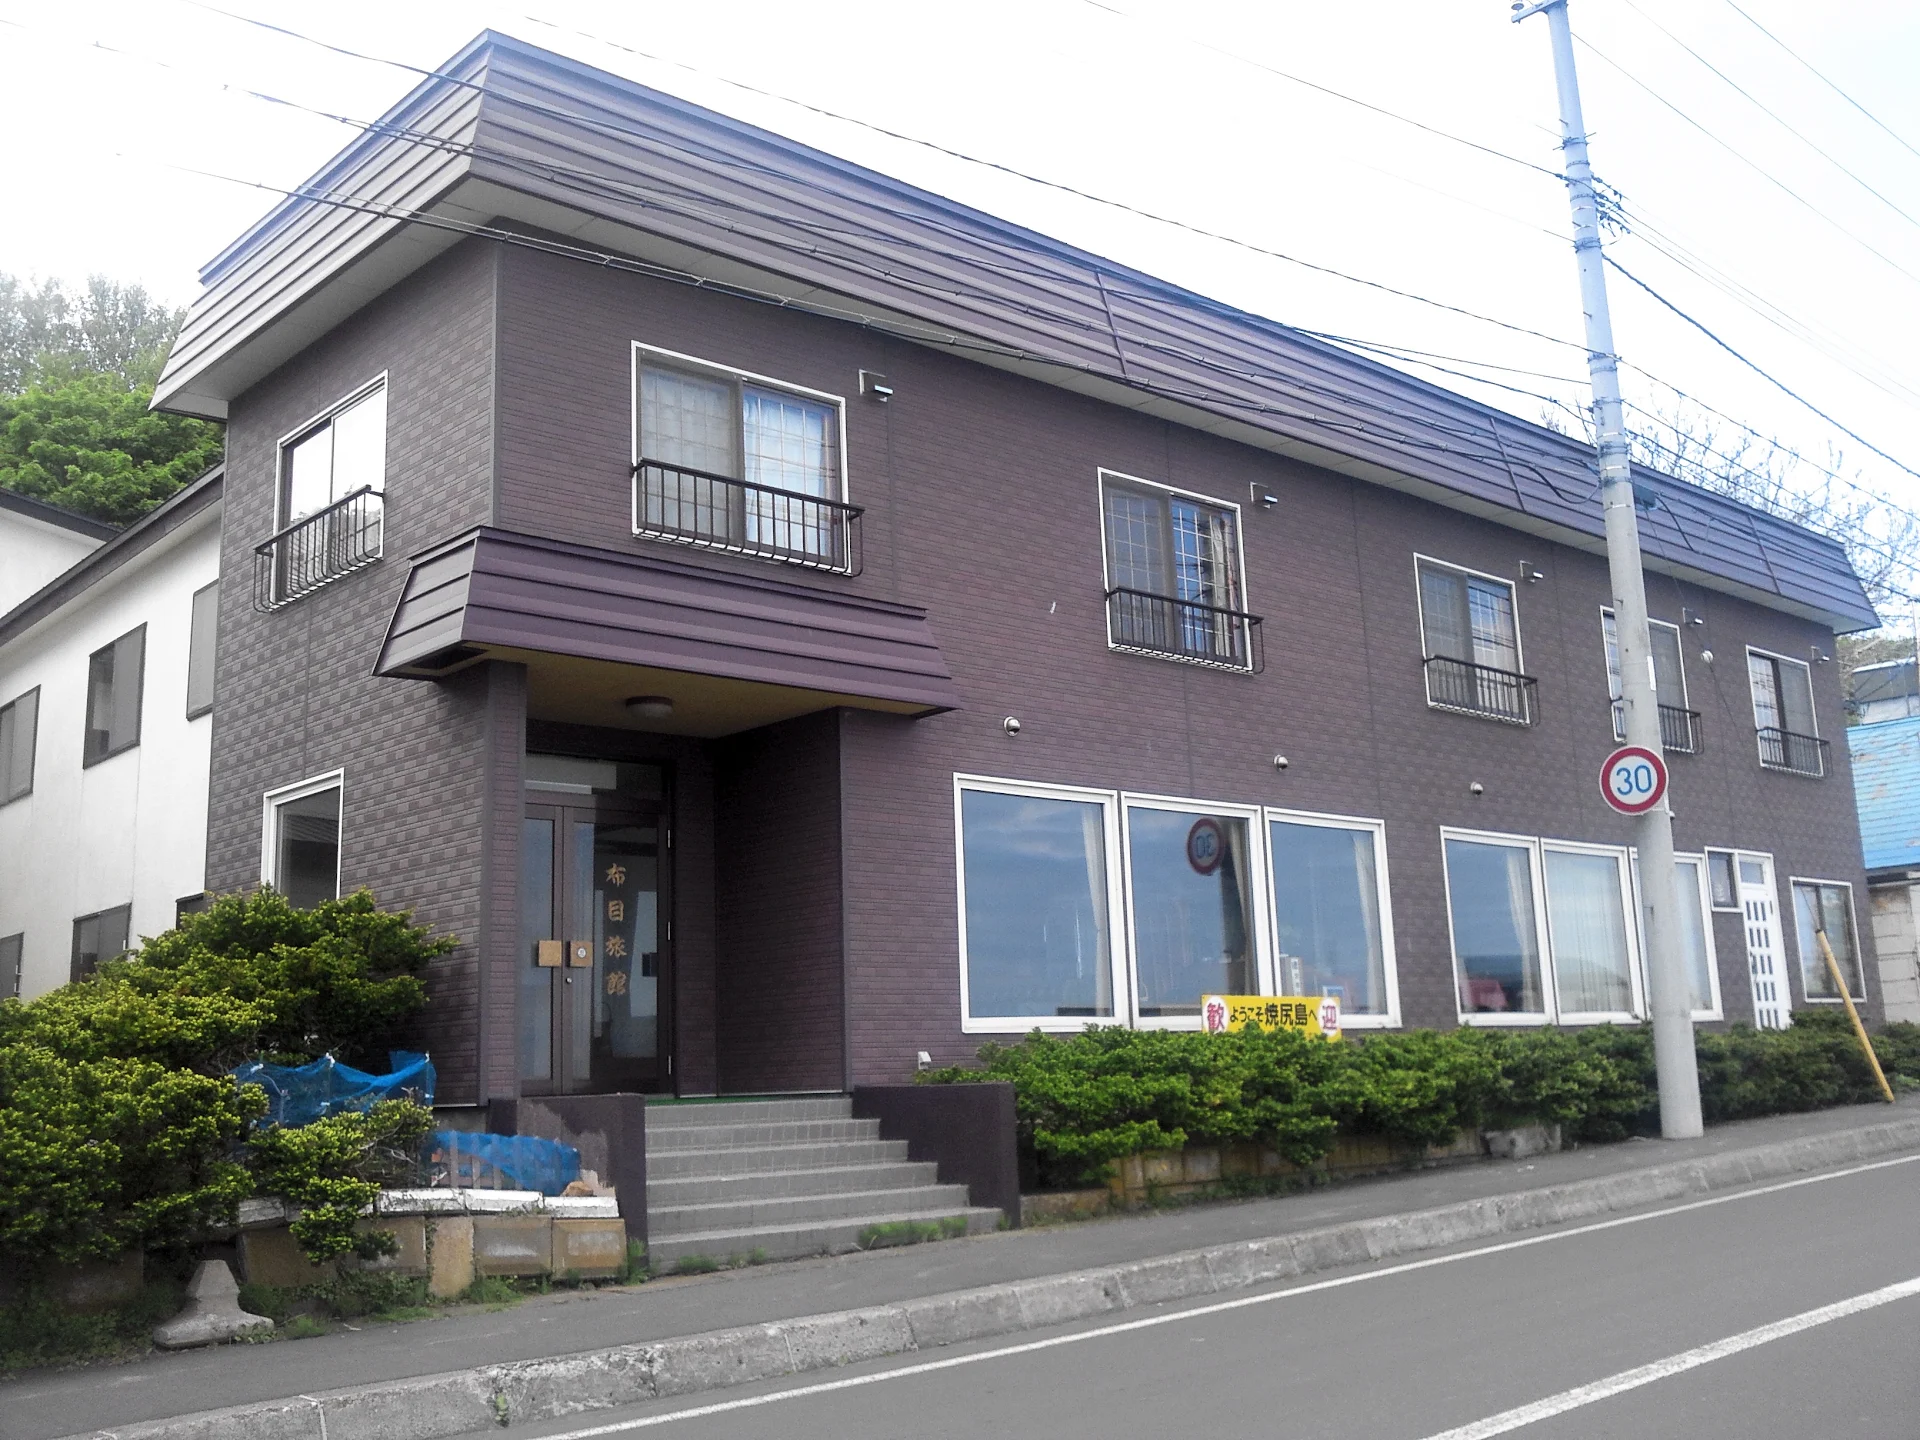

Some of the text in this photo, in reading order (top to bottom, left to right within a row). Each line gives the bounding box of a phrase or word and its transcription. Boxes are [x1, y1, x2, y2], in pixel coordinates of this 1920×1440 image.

[1616, 765, 1652, 795] 30
[605, 862, 628, 996] 布目旅館
[1229, 1002, 1318, 1026] ようこそ焼尻島へ
